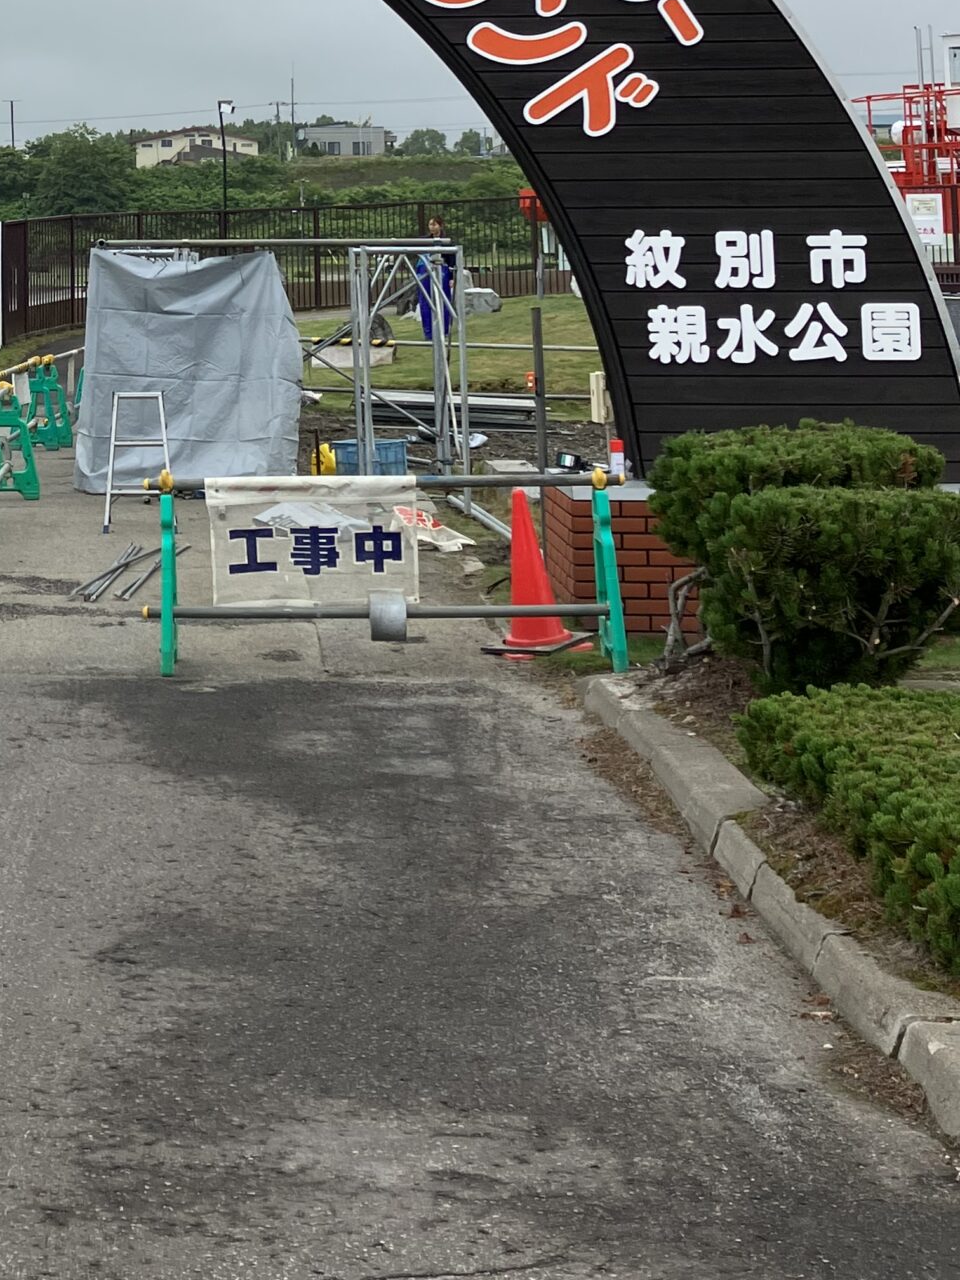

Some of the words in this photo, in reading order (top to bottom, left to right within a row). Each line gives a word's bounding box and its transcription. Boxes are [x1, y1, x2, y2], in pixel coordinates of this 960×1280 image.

[623, 228, 869, 290] 紋別市
[646, 300, 923, 365] 親水公園
[229, 525, 402, 575] 工事中
